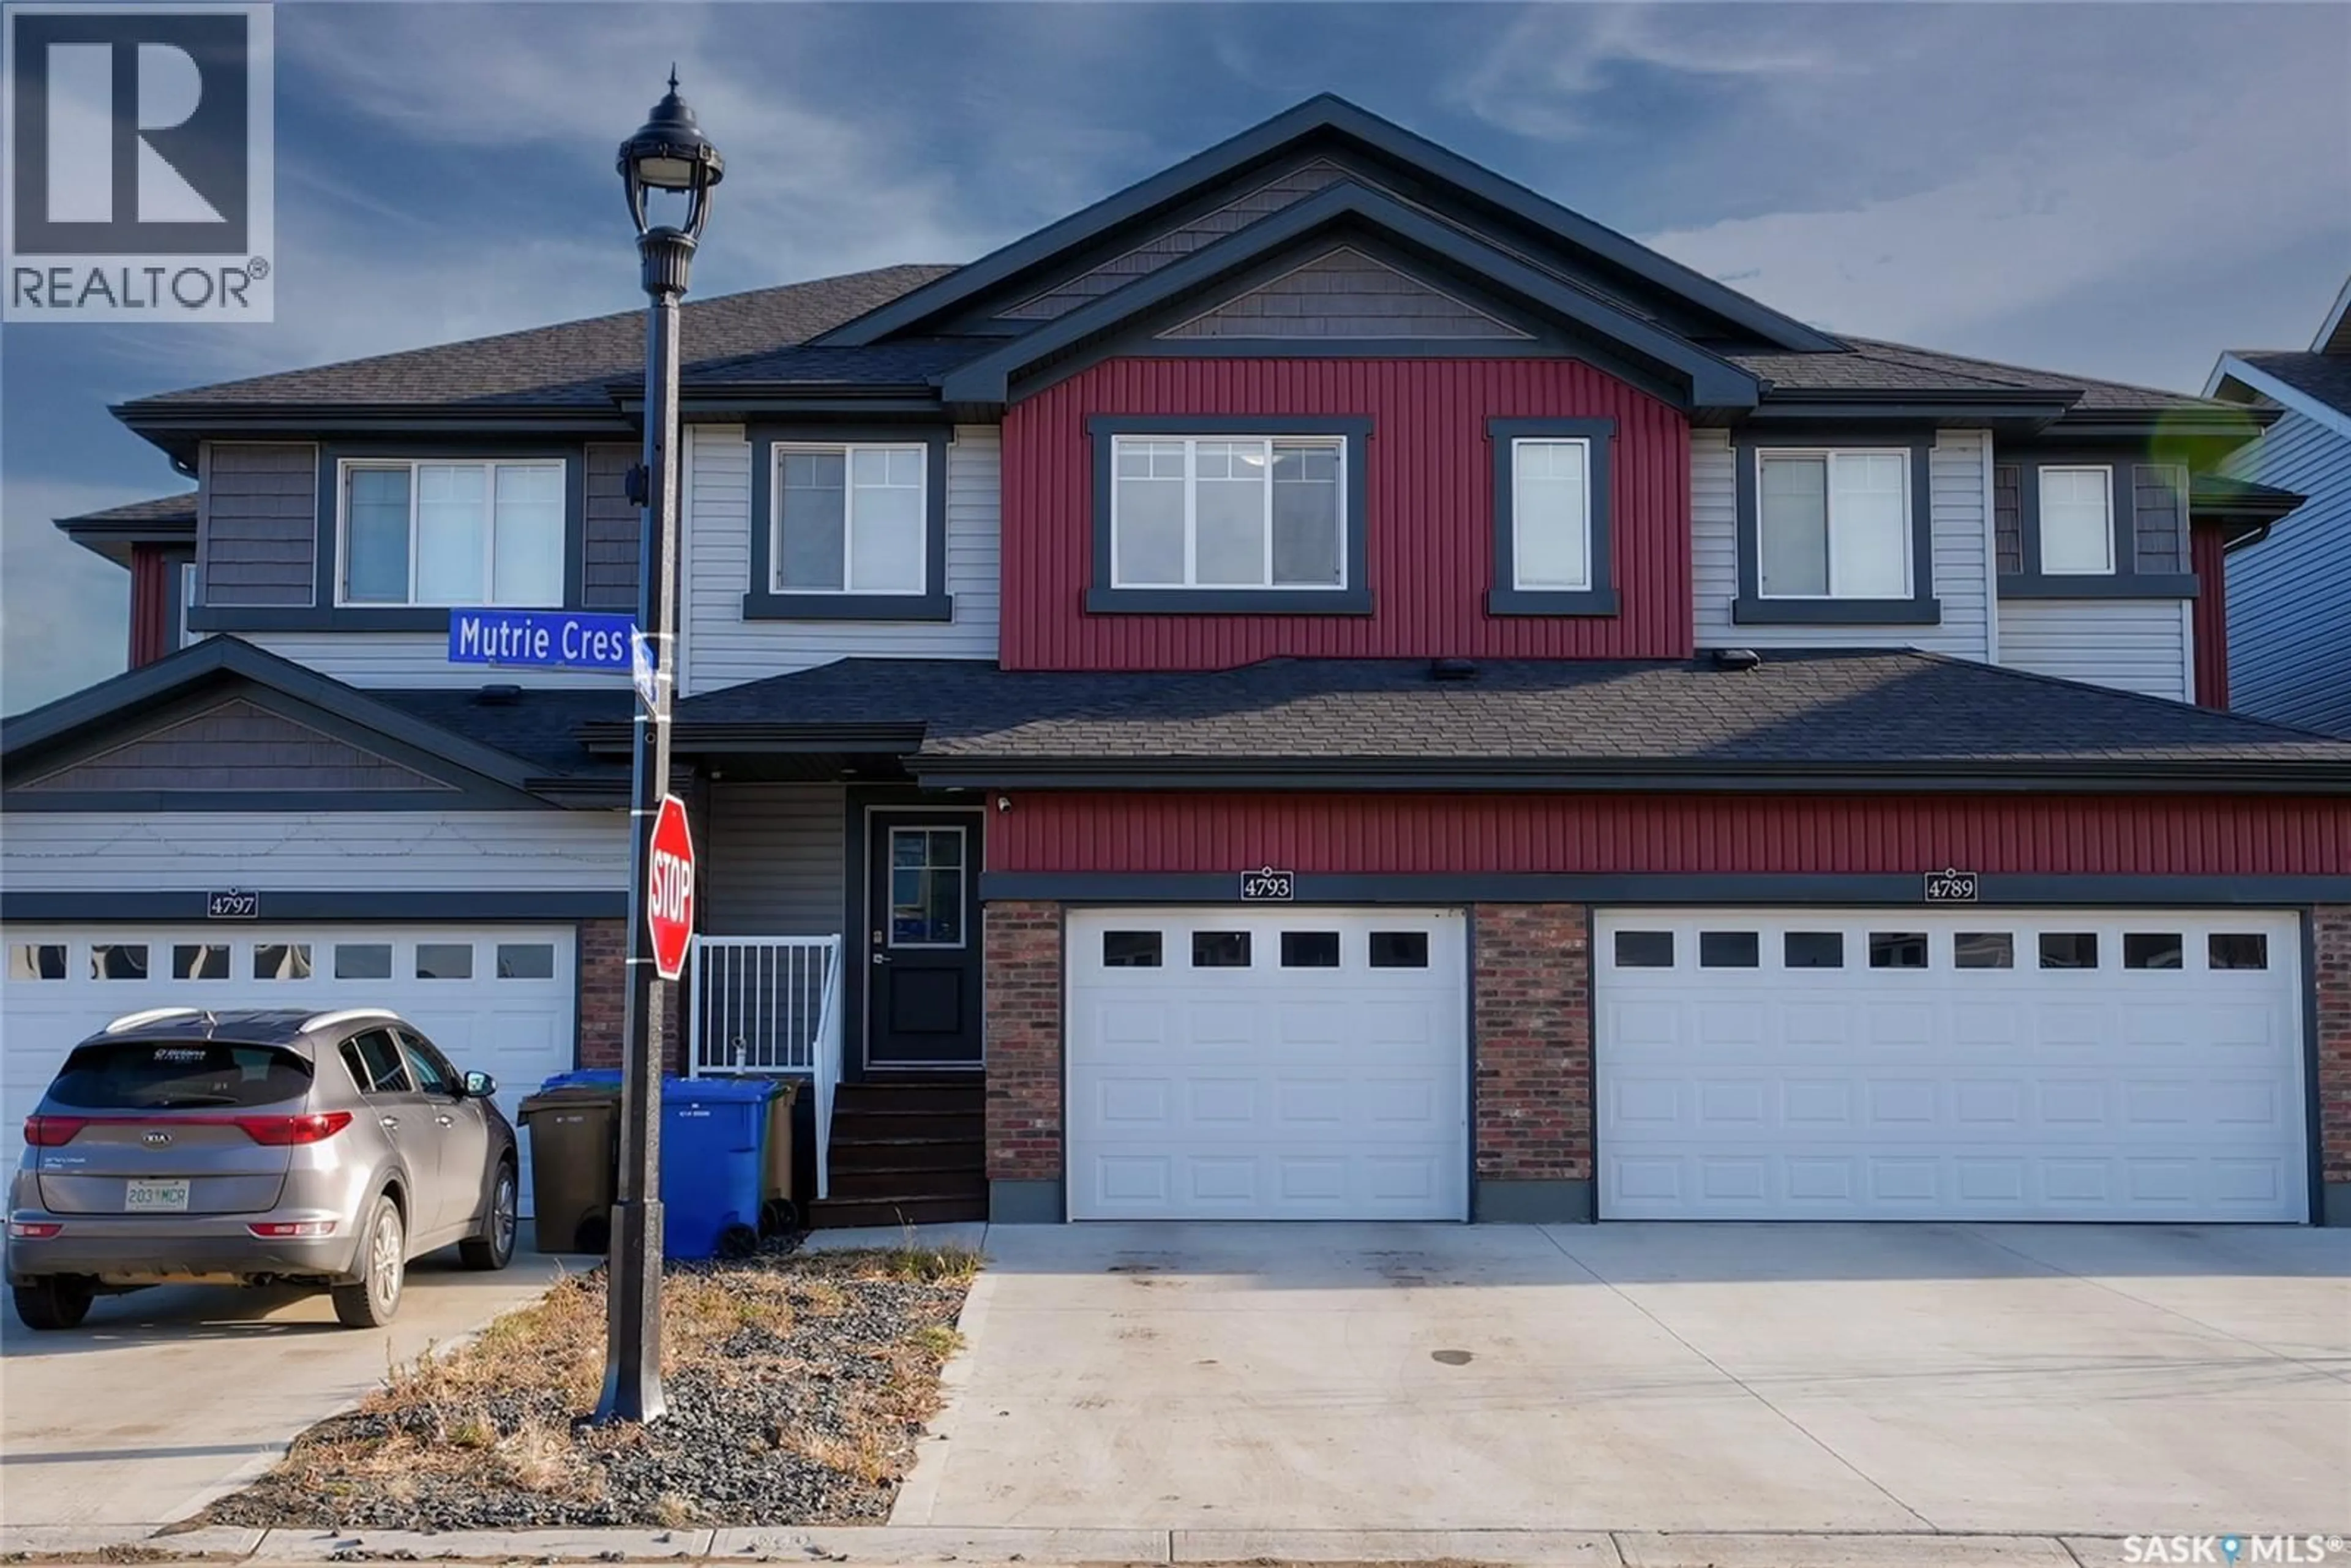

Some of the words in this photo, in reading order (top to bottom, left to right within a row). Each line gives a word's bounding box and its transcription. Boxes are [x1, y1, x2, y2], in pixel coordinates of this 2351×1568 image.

[460, 617, 550, 659] Mutrie
[563, 621, 623, 661] Cres
[653, 849, 691, 923] STOP
[1245, 878, 1289, 896] 4793
[1929, 879, 1973, 898] 4789
[211, 896, 255, 913] 4797
